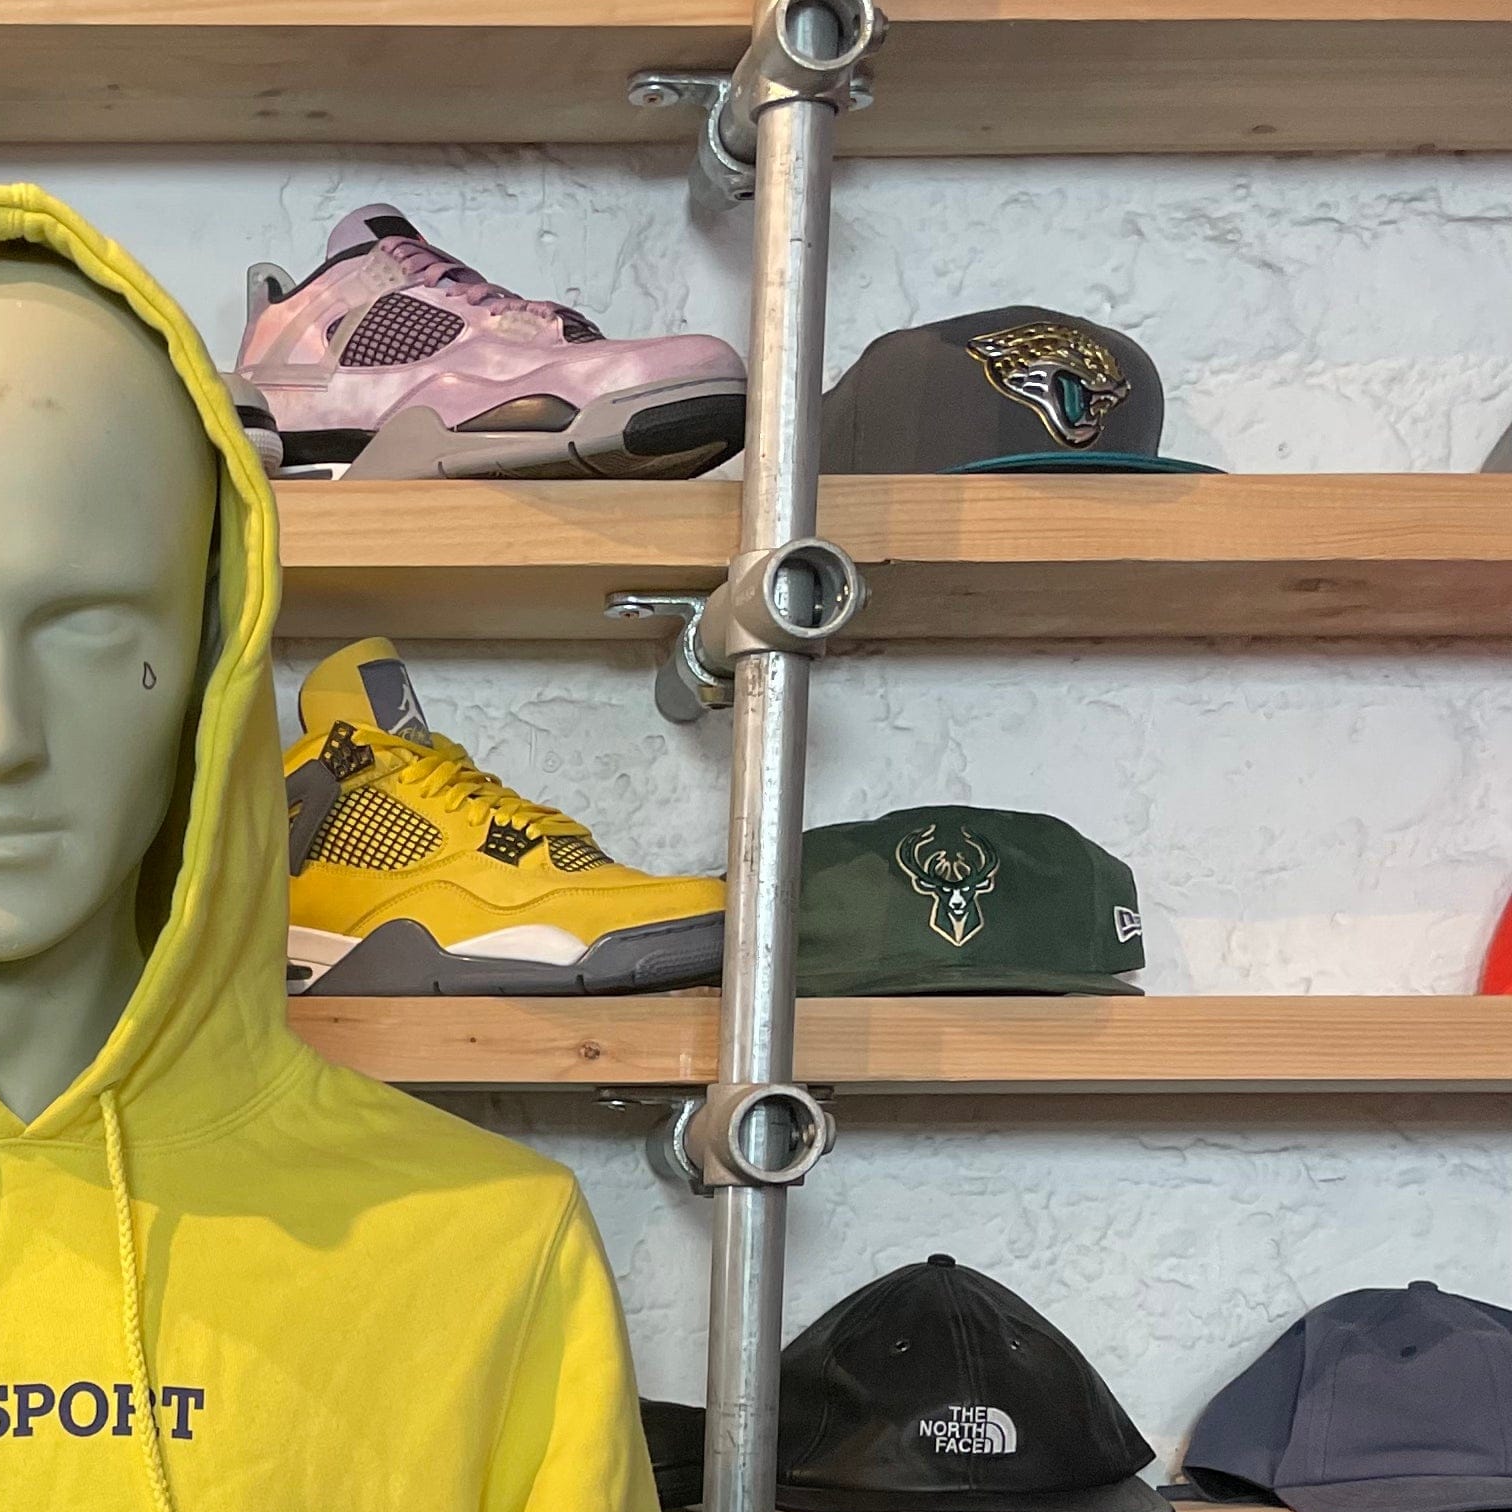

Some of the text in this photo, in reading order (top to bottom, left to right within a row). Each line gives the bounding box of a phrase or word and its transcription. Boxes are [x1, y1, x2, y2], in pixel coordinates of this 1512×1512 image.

[948, 1406, 987, 1423] THE
[919, 1419, 986, 1439] NORTH
[935, 1437, 985, 1454] FACE
